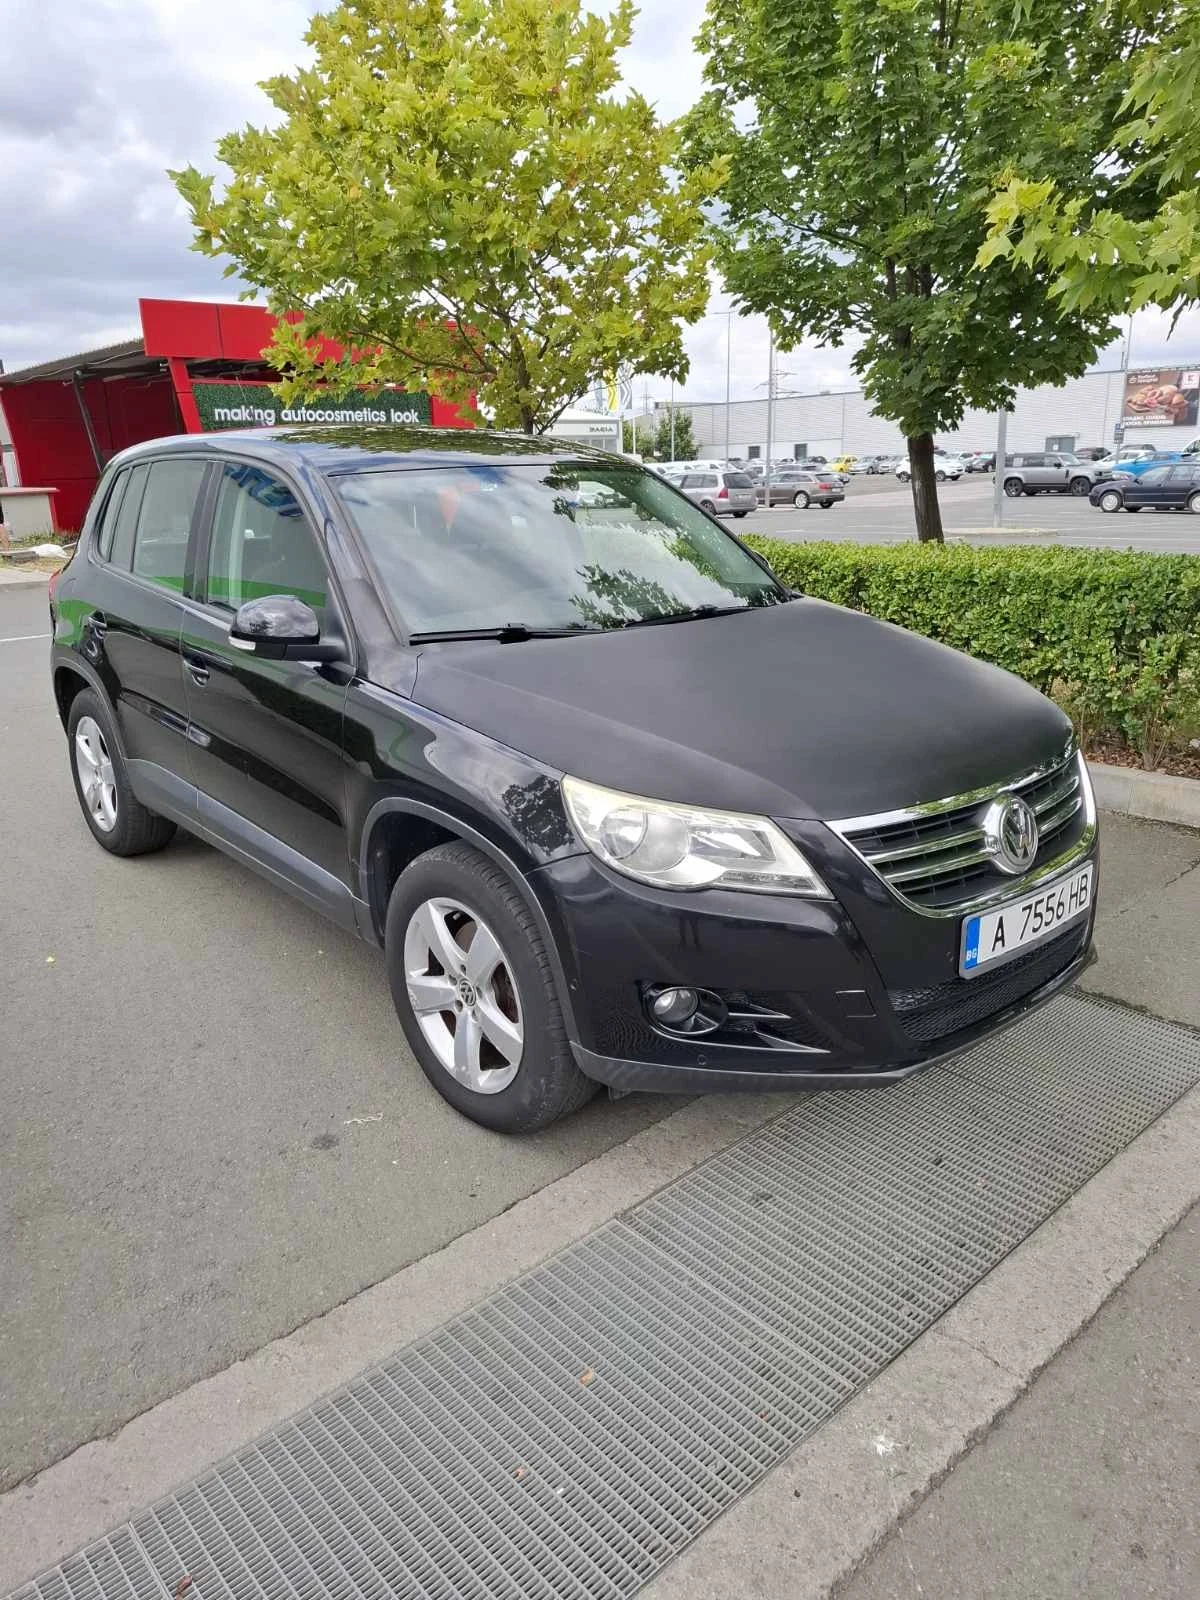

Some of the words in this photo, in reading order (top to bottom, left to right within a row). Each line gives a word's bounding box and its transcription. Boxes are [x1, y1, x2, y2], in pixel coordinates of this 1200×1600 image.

[281, 406, 387, 422] autocosmetics
[390, 408, 419, 423] look
[991, 915, 1005, 952] A
[1019, 887, 1065, 940] 7556
[1067, 873, 1089, 914] HB
[966, 948, 978, 960] BG
